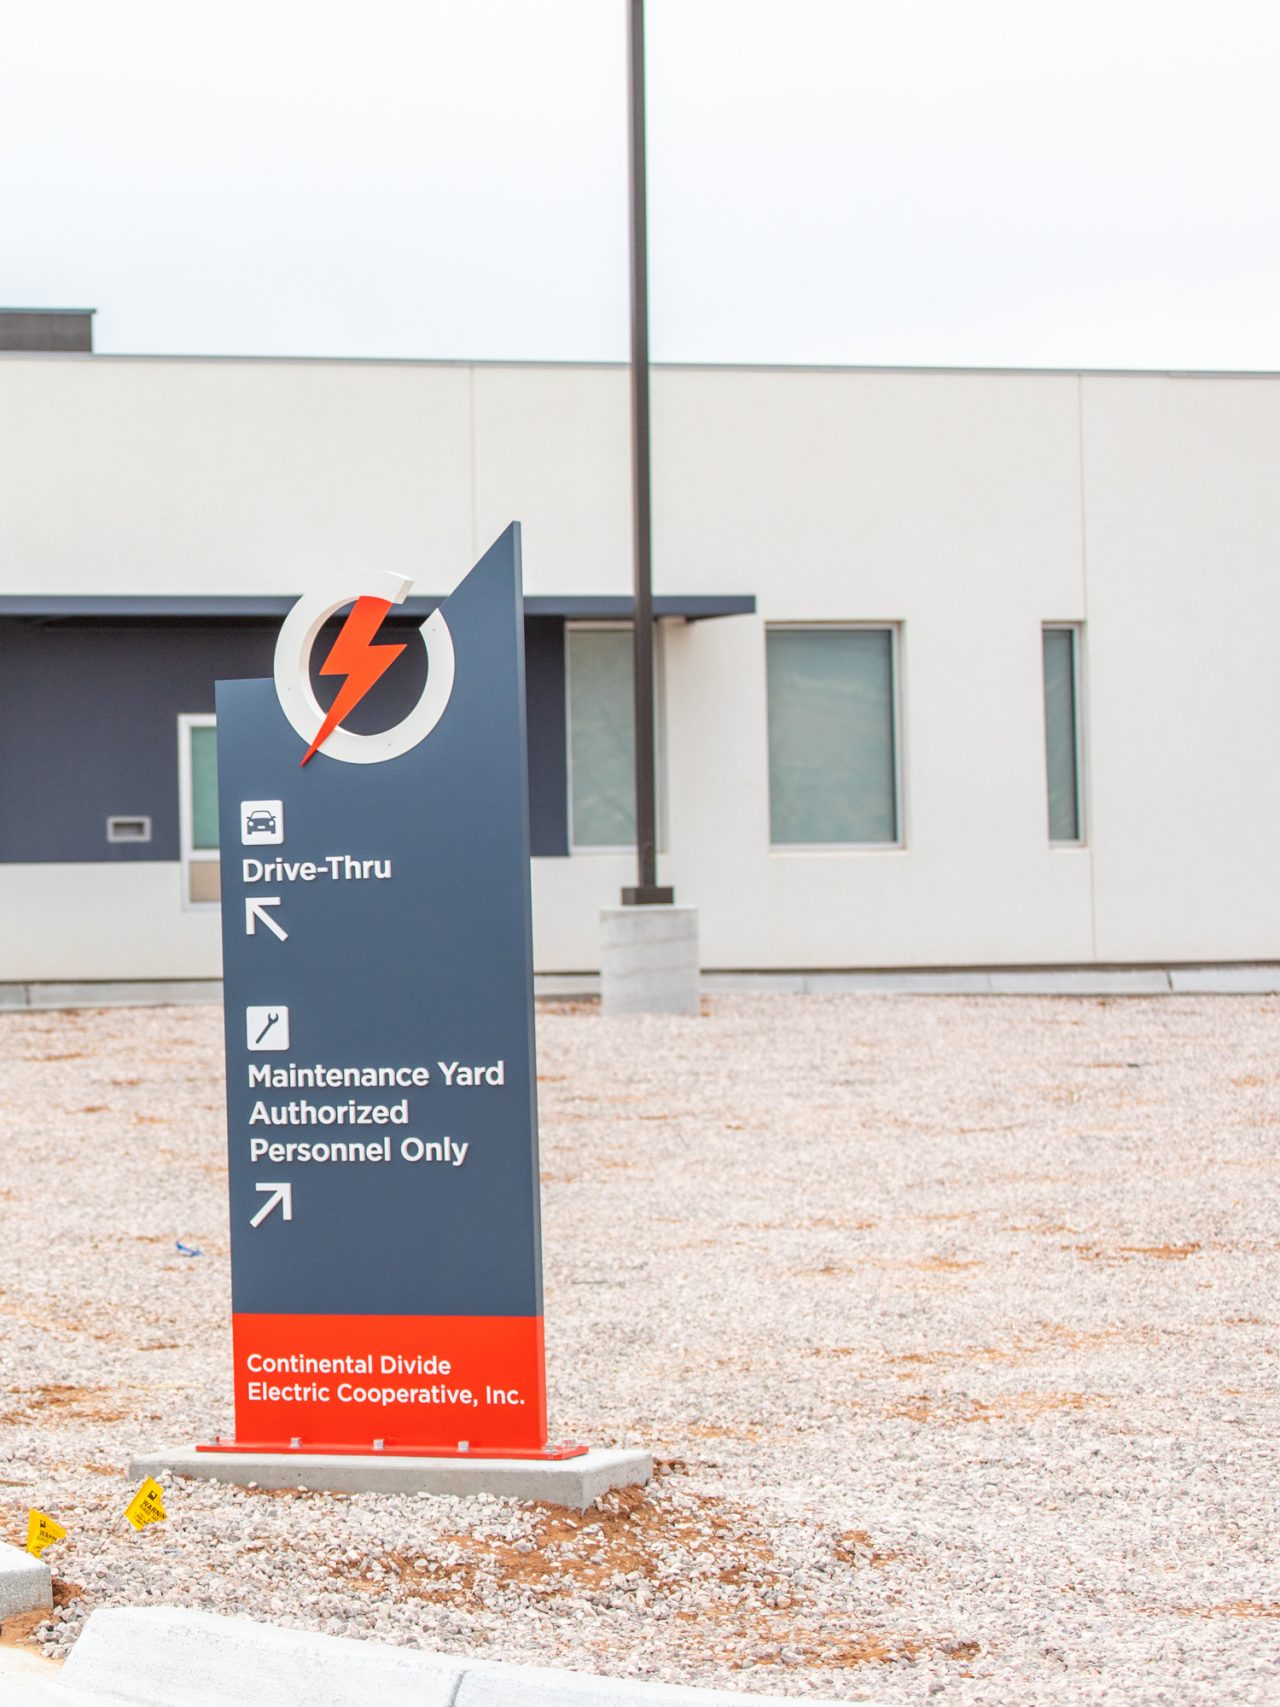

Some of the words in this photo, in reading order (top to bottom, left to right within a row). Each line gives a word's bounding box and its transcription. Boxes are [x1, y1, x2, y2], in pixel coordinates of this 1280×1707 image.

[242, 854, 392, 883] Drive-Thru
[248, 1062, 430, 1088] Maintenance
[437, 1060, 505, 1086] Yard
[248, 1098, 409, 1125] Authorized
[249, 1136, 391, 1162] Personnel
[400, 1135, 469, 1167] Only
[246, 1353, 373, 1374] Continental
[380, 1355, 452, 1376] Divide
[247, 1381, 330, 1402] Electric
[336, 1383, 479, 1408] Cooperative,
[485, 1385, 525, 1405] Inc.
